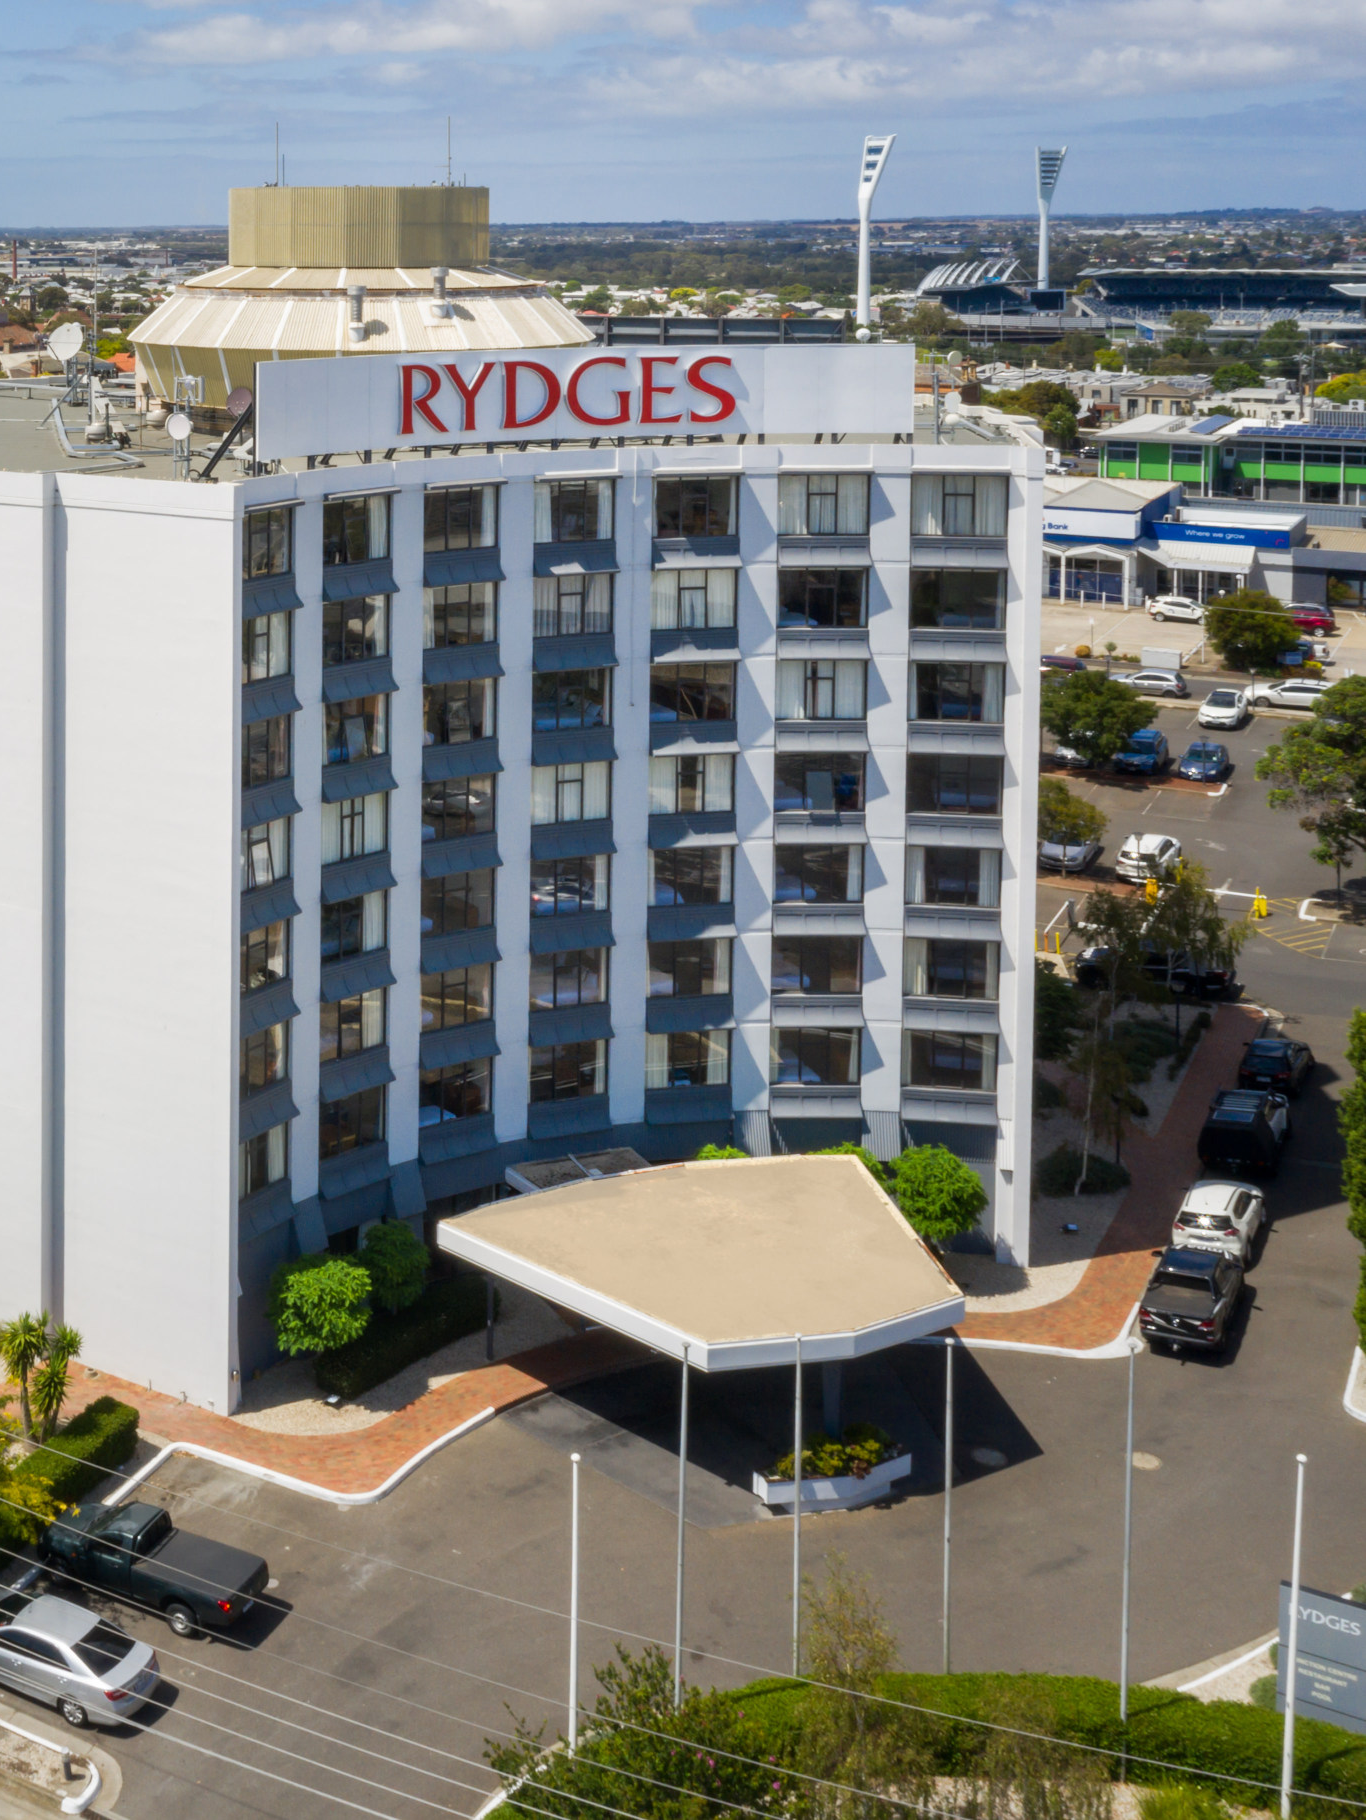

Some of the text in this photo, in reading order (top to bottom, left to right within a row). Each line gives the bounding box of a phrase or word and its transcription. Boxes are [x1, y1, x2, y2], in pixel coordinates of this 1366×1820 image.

[398, 356, 736, 434] RYDGES
[1047, 522, 1068, 530] Bank
[1185, 529, 1211, 538] Where
[1297, 1667, 1348, 1688] RESTAURANT
